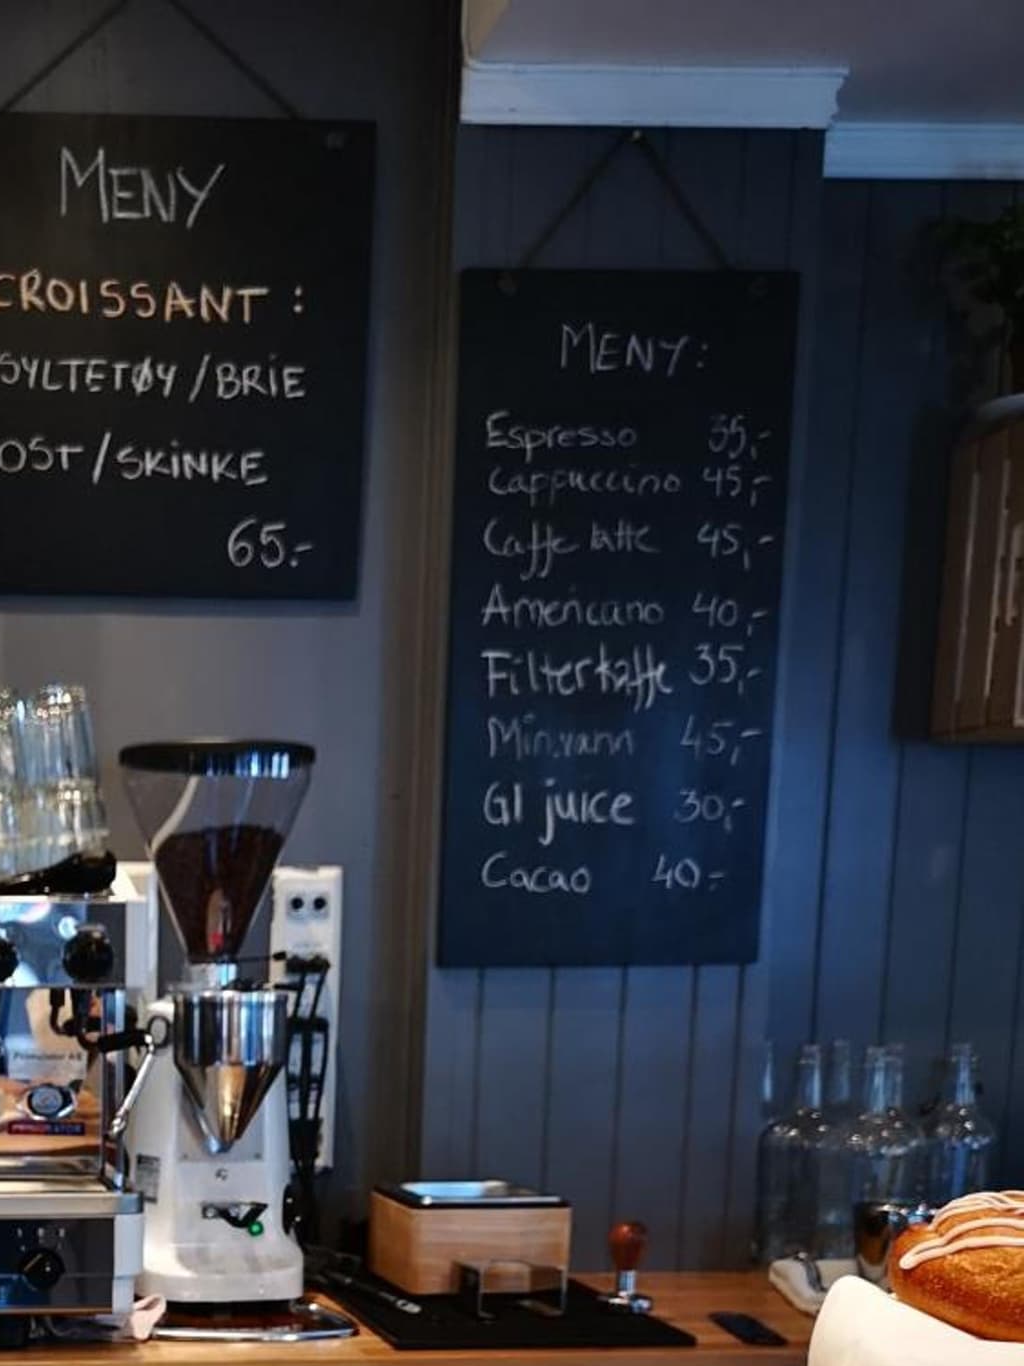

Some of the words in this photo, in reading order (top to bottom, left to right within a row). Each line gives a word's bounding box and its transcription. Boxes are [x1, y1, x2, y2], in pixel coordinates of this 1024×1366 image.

[59, 146, 225, 229] MENY
[560, 322, 708, 376] MENY:
[485, 411, 638, 463] Espresso
[487, 463, 682, 507] Cappuccino
[481, 583, 666, 629] Americano
[480, 641, 674, 713] Filterkaffe
[538, 777, 636, 846] juice
[481, 851, 591, 894] Cacao
